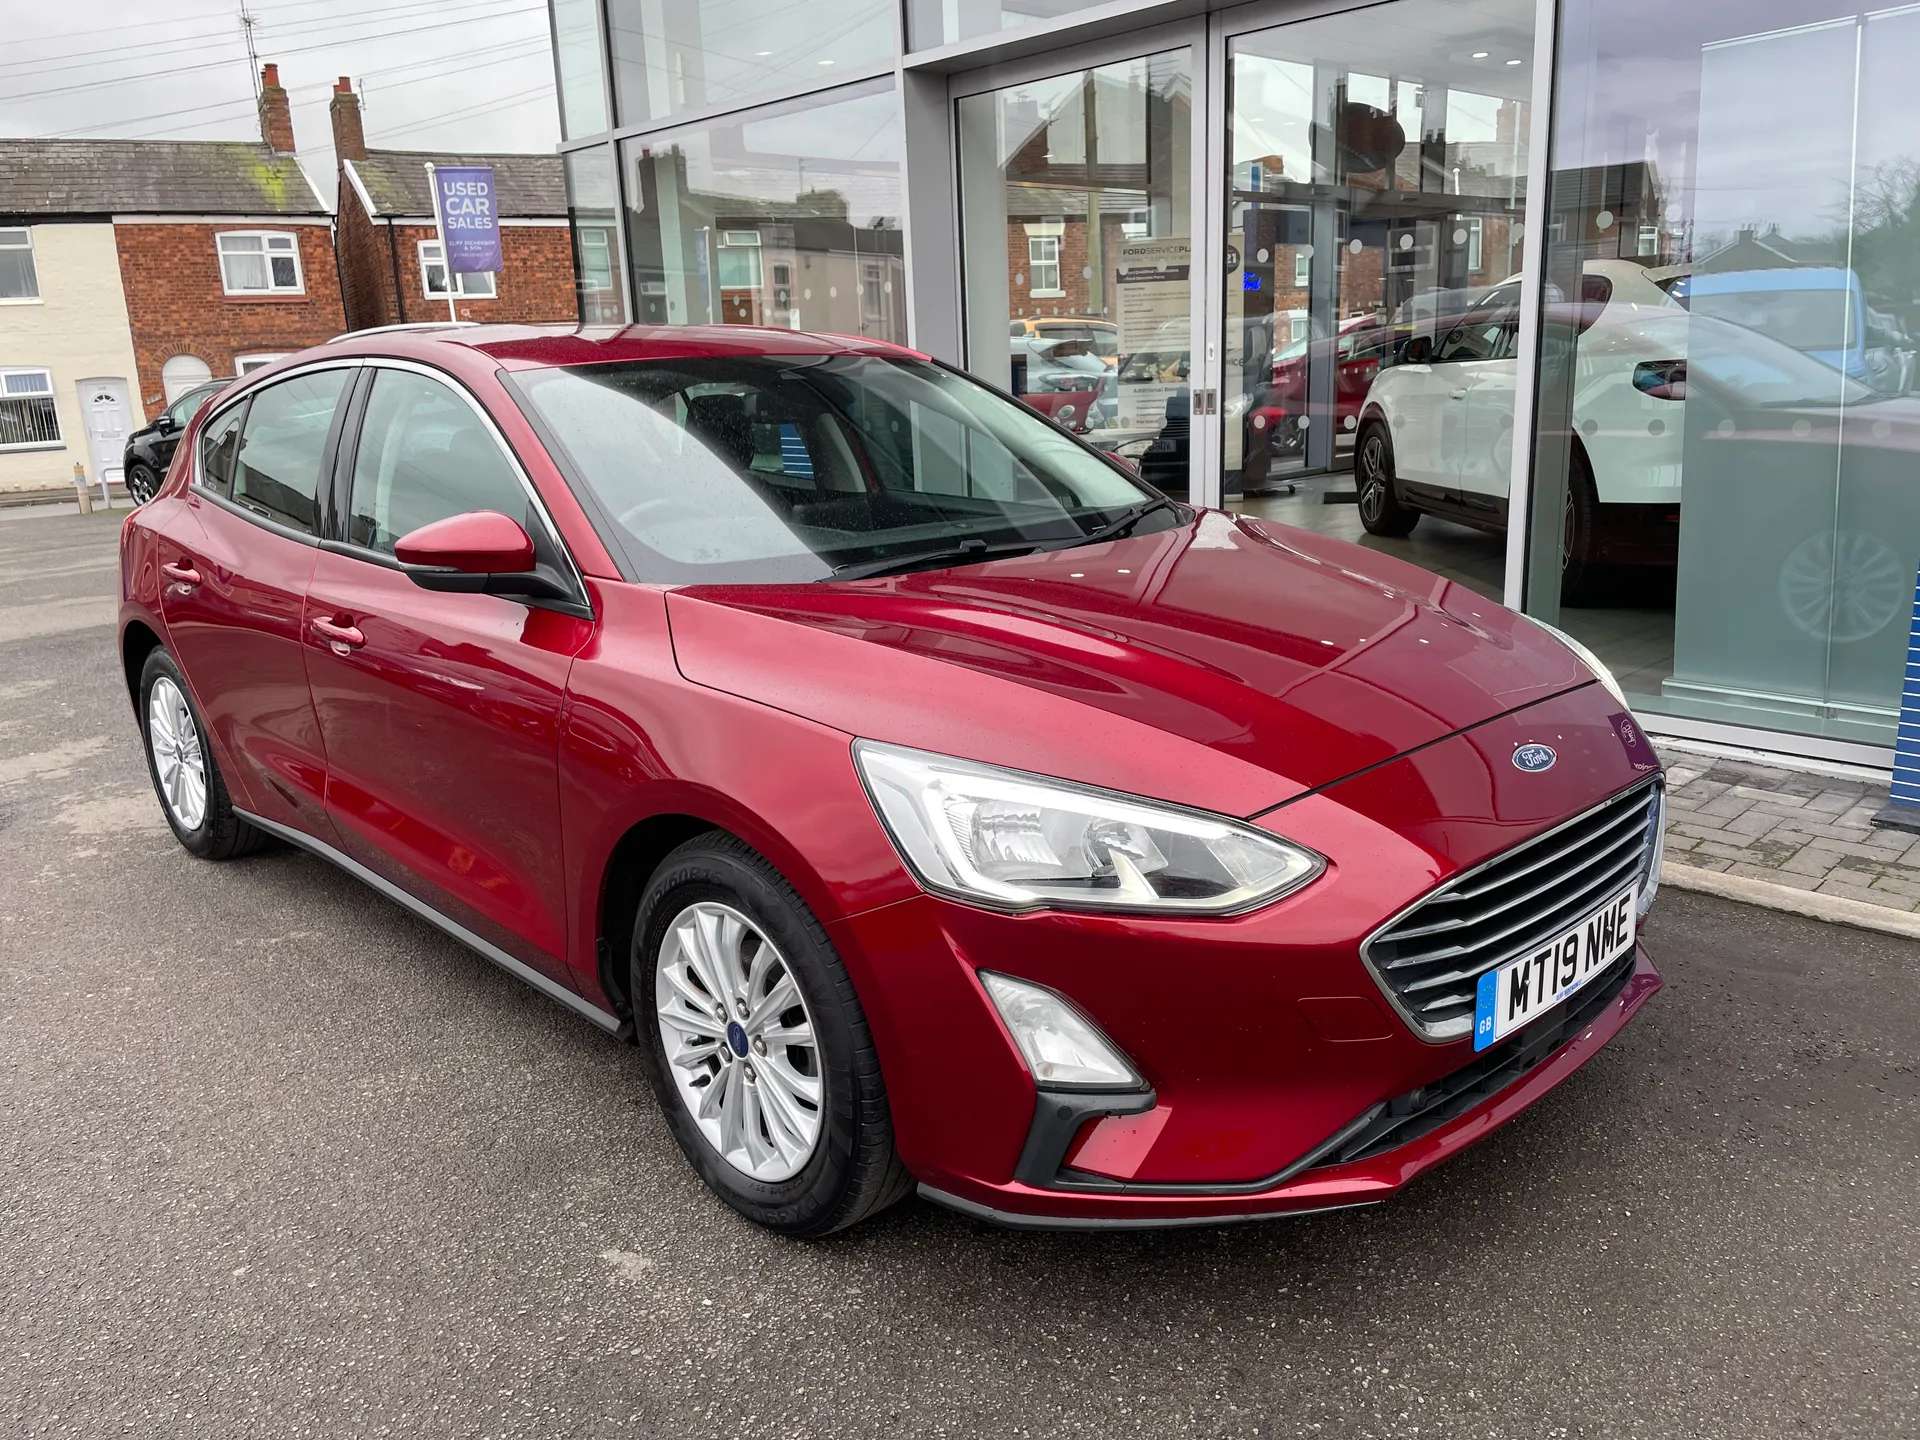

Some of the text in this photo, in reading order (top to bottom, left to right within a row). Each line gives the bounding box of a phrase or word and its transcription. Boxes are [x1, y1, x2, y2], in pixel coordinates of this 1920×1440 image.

[444, 182, 488, 195] USED
[446, 198, 490, 215] CAR
[447, 217, 493, 229] SALES
[1521, 749, 1549, 767] Ford
[1509, 893, 1631, 1021] MT19 NME
[1479, 1017, 1492, 1034] GB
